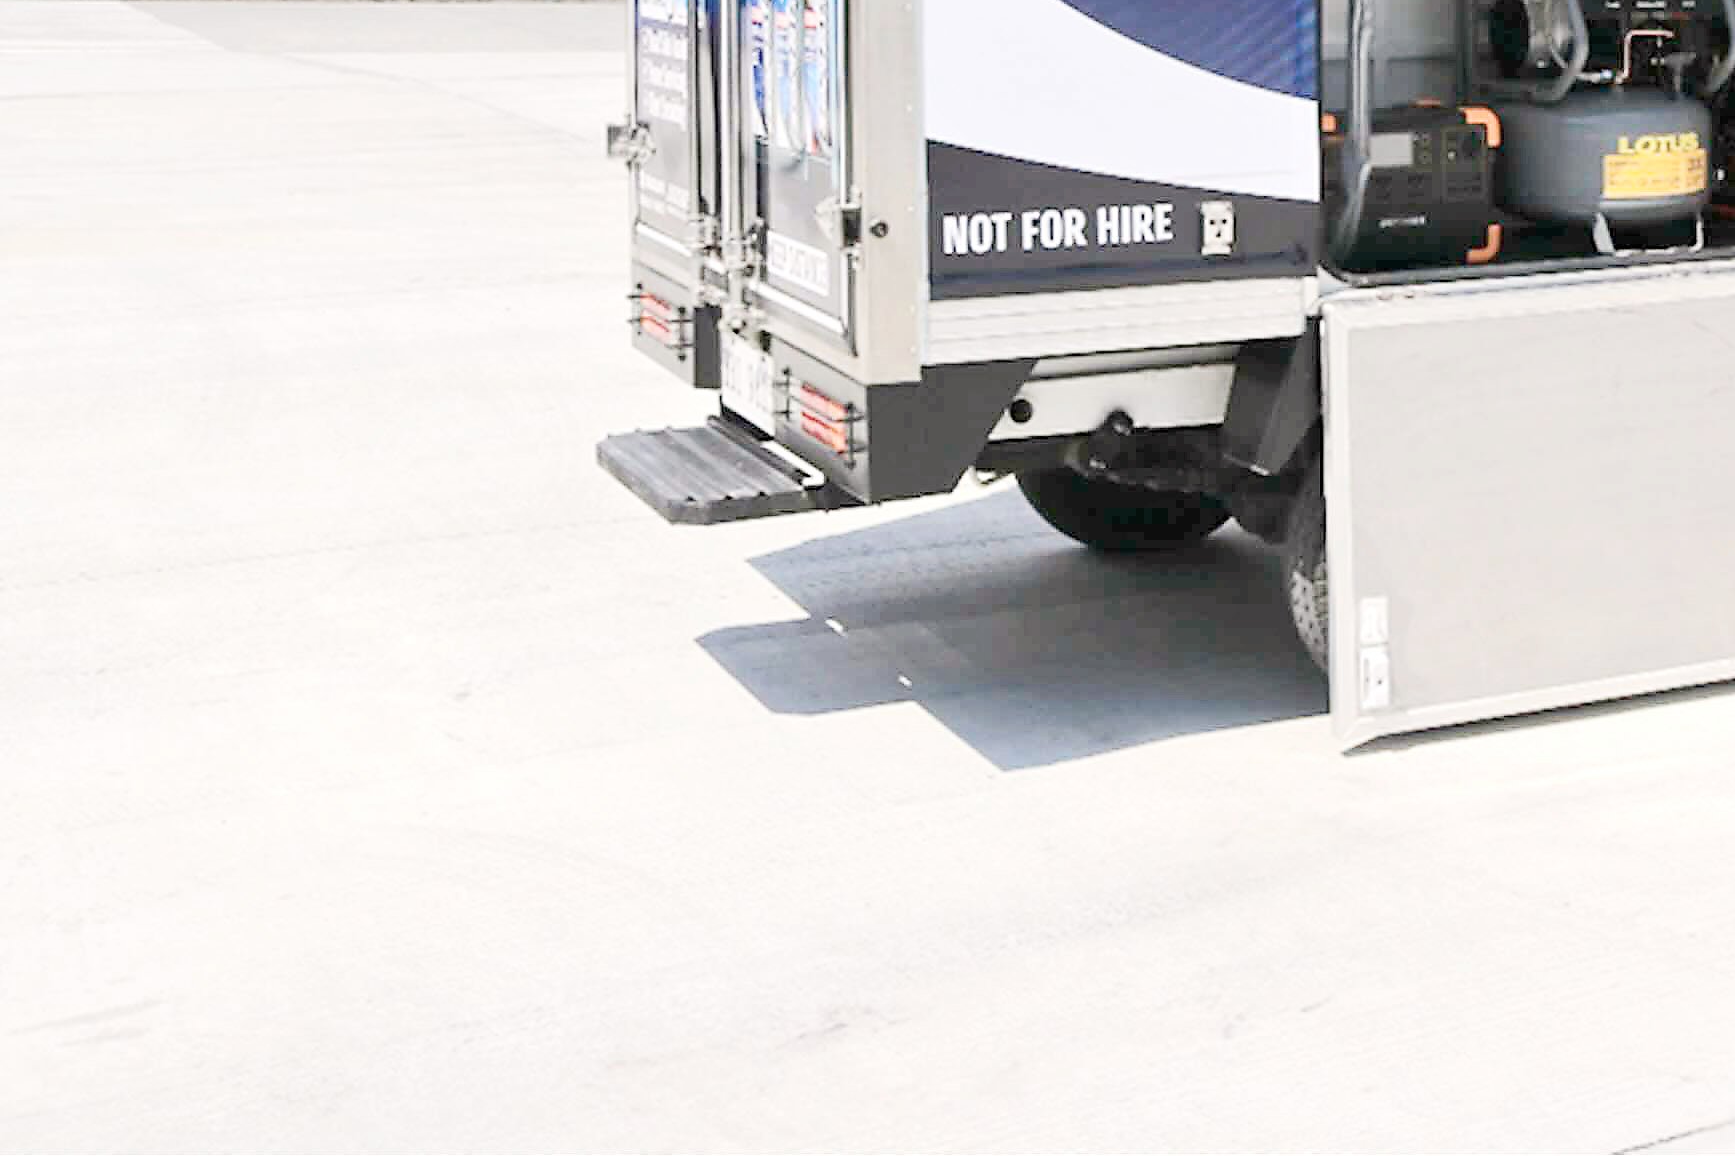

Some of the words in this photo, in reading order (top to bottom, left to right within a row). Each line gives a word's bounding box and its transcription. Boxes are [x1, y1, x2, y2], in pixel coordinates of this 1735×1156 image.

[1617, 132, 1699, 155] LOTUS
[942, 211, 1014, 255] NOT
[1020, 207, 1088, 252] FOR
[1096, 201, 1175, 246] HIRE
